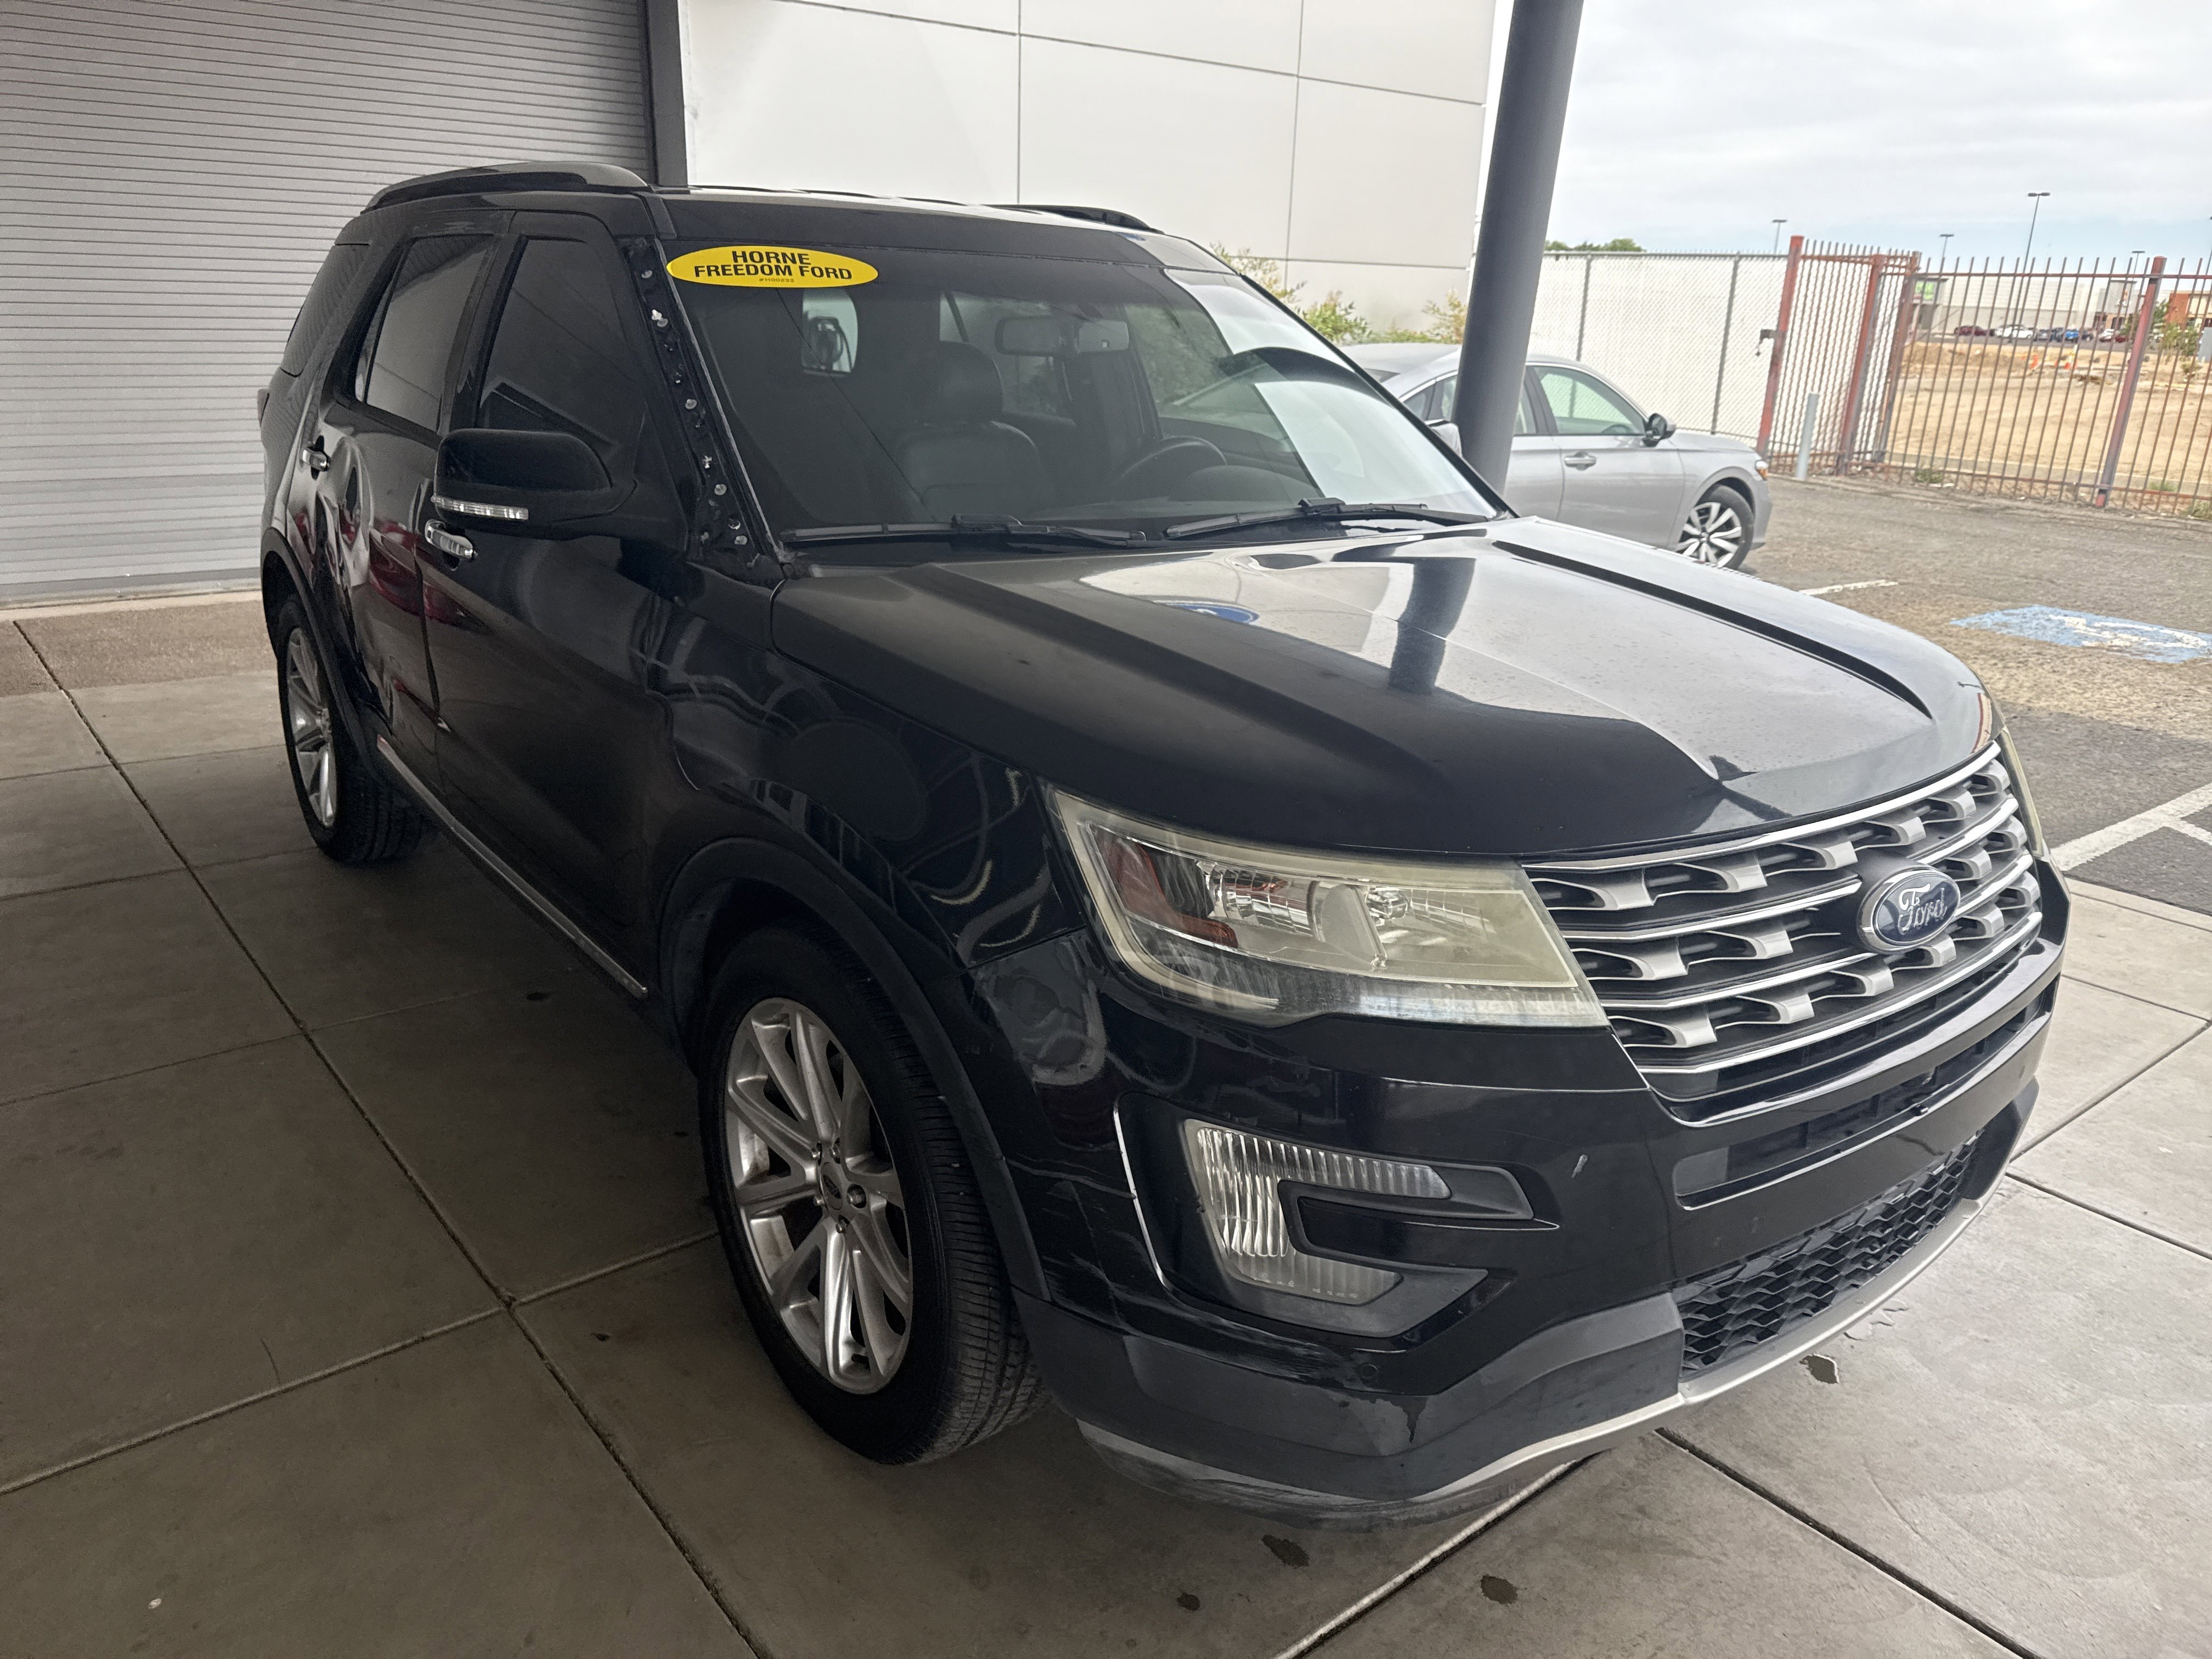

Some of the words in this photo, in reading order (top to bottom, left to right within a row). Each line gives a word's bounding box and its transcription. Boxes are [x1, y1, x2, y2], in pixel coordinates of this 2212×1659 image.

[732, 251, 811, 265] HORNE
[694, 264, 793, 277] FREEDOM
[799, 266, 852, 279] FORD
[1898, 883, 1947, 935] Ford
